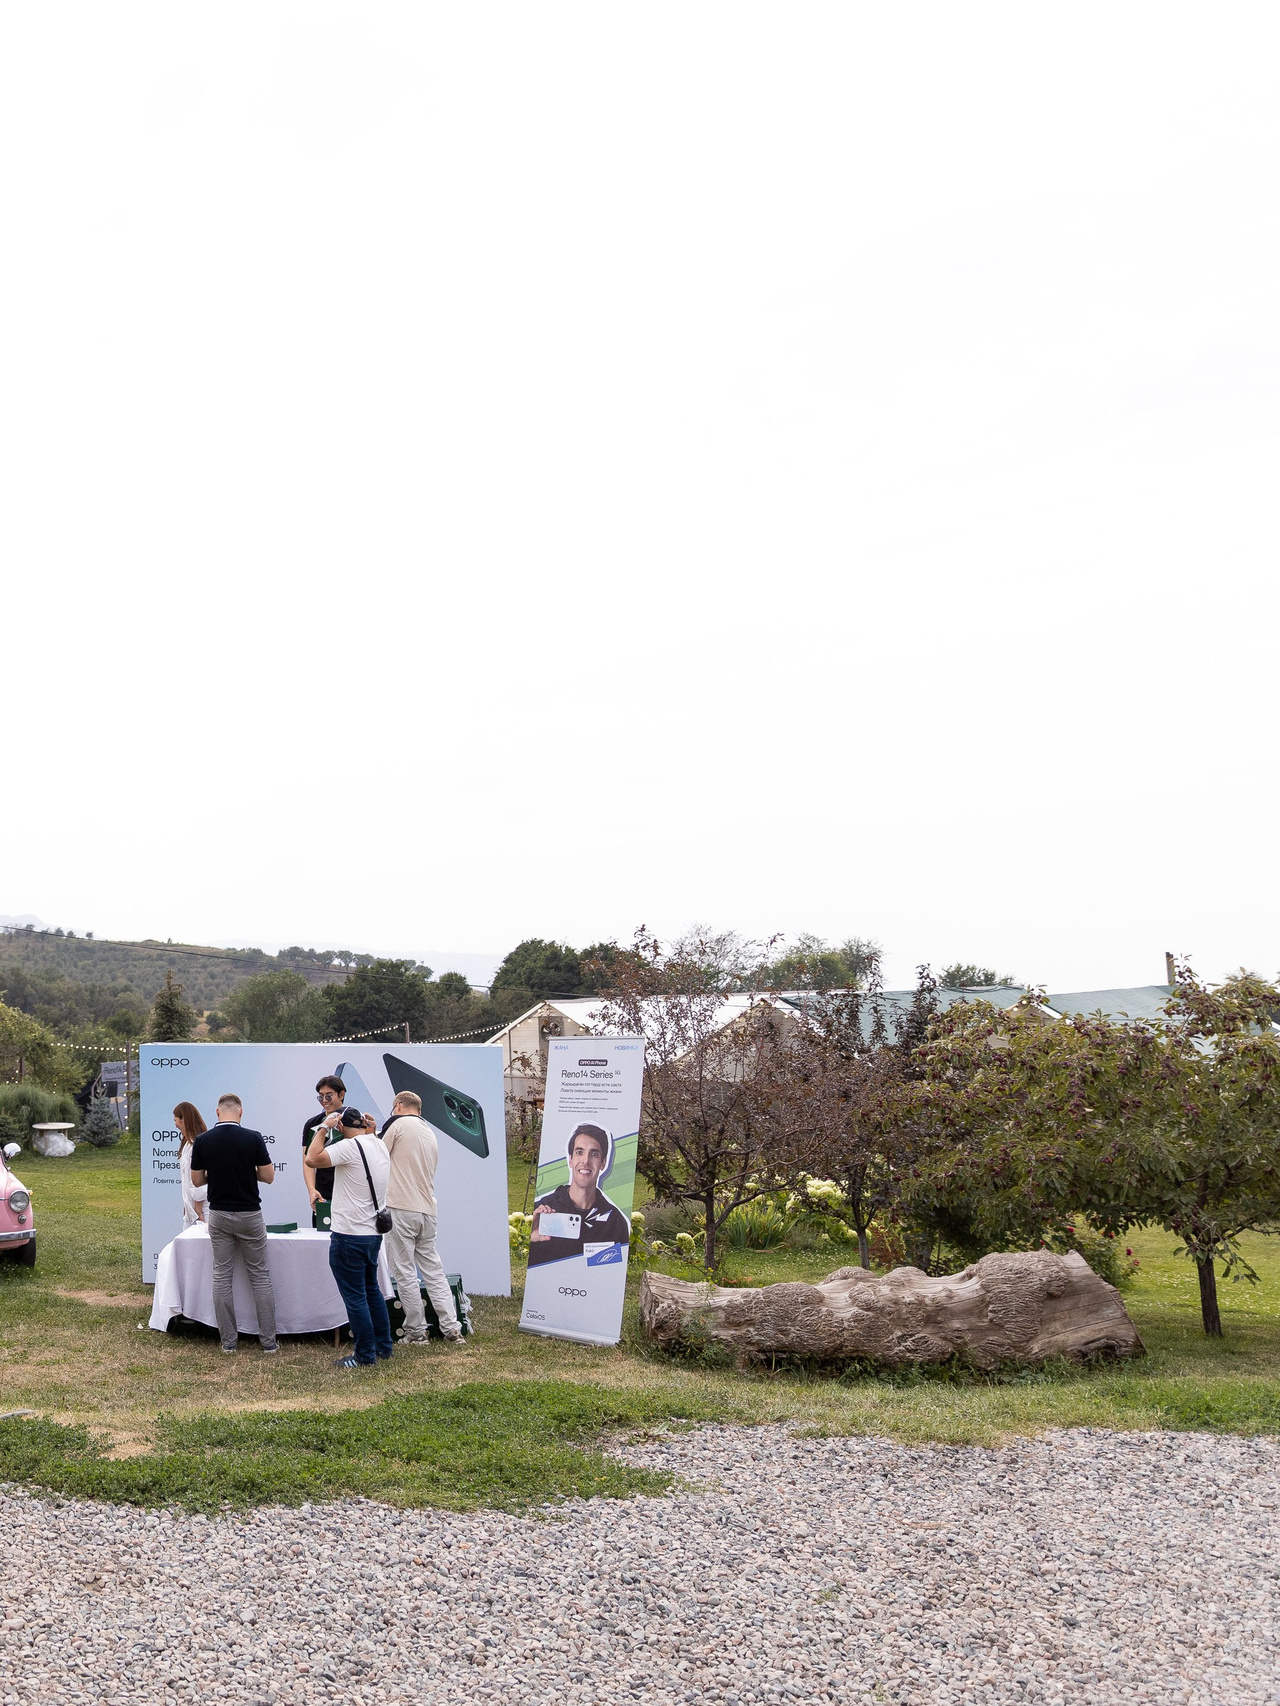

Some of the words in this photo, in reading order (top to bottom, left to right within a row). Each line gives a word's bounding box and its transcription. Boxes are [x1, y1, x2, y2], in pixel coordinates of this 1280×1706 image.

[151, 1057, 190, 1069] oppo
[561, 1070, 588, 1078] Reno14
[590, 1069, 613, 1079] Series
[558, 1286, 587, 1297] oppo
[526, 1312, 545, 1321] ColorOS
